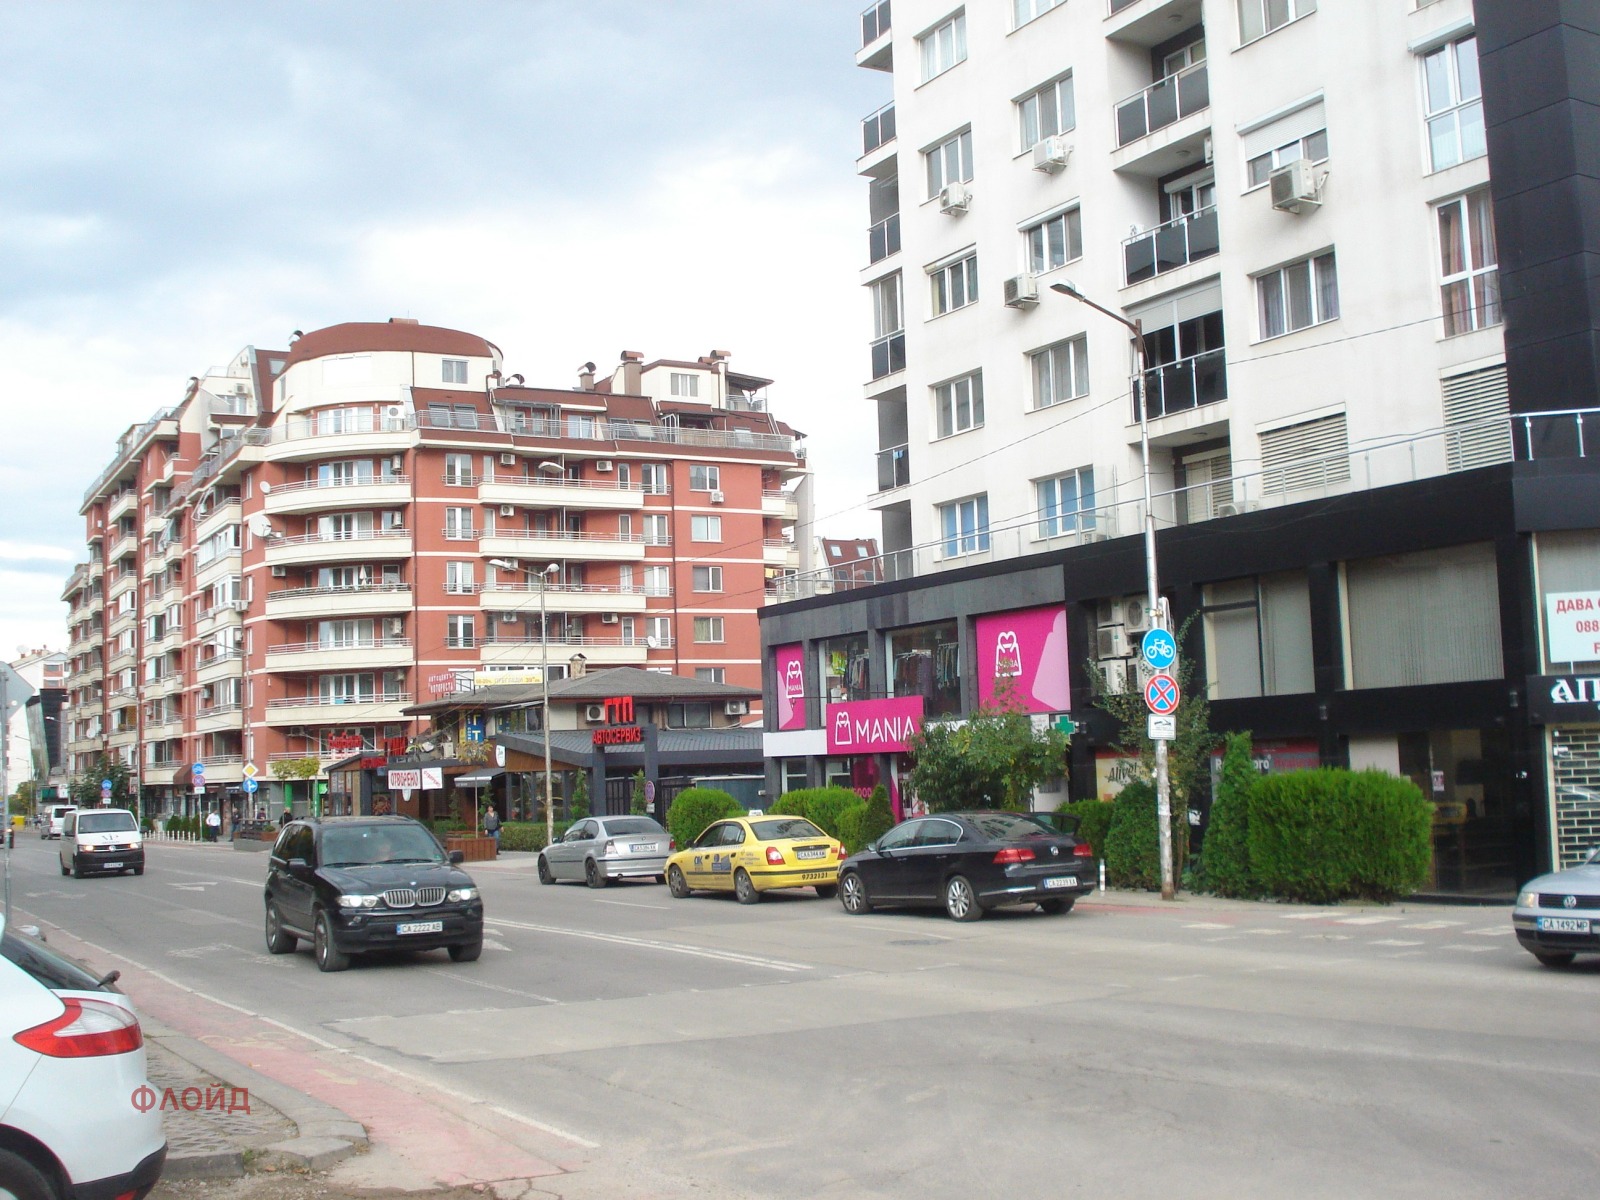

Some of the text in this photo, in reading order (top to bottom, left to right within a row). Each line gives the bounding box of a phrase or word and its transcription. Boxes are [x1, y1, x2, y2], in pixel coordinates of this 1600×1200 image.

[1556, 599, 1594, 614] ДАВА
[604, 695, 634, 725] ГТП
[592, 726, 641, 744] АВТОСЕРВИЗ
[855, 715, 915, 744] MANIA
[390, 772, 418, 787] ОТВОРЕНО
[801, 872, 828, 881] 9732121
